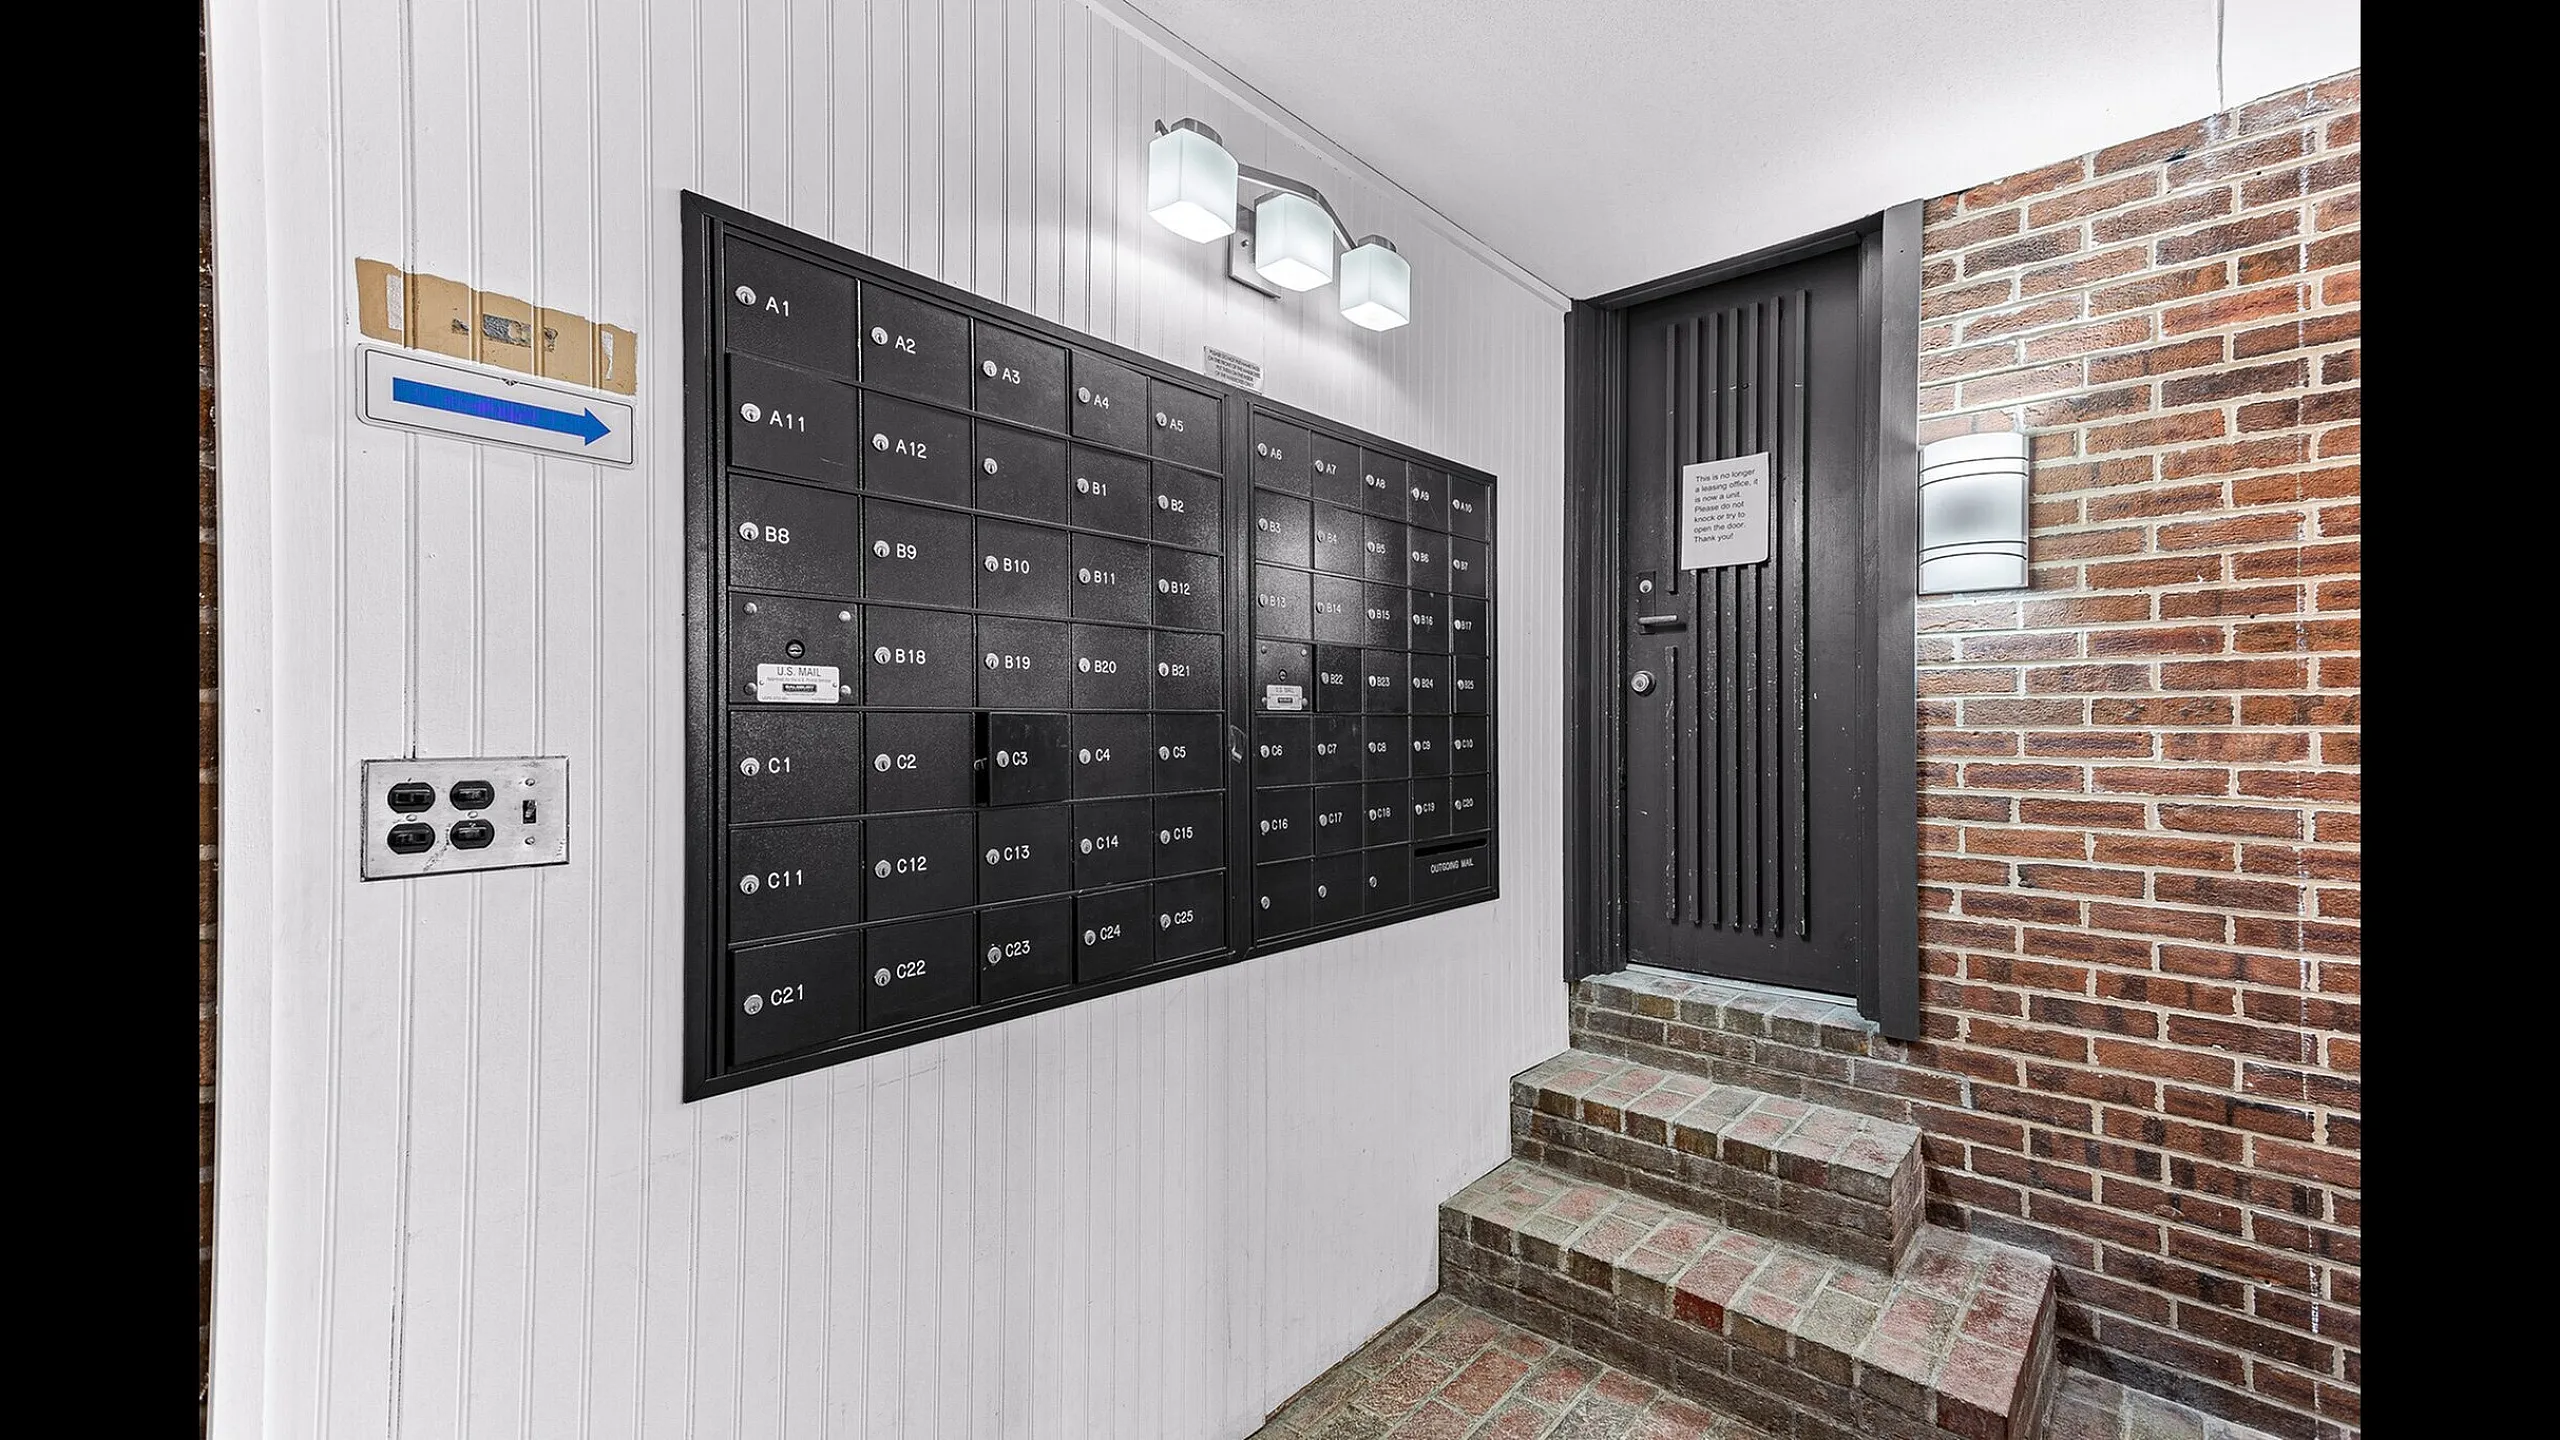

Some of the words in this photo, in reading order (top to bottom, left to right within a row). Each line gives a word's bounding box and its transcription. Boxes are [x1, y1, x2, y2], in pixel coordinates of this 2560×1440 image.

[765, 296, 789, 317] A1
[894, 335, 916, 355] A2
[1002, 367, 1021, 385] A3
[1093, 394, 1109, 410] A4
[769, 410, 805, 432] A11
[1169, 418, 1184, 432] A5
[895, 439, 927, 459] A12
[1270, 447, 1283, 461] A6
[1325, 463, 1337, 475] A7
[1731, 469, 1755, 478] longer
[1092, 481, 1107, 496] B1
[1375, 477, 1386, 489] A8
[1701, 483, 1727, 492] leasing
[1419, 490, 1431, 502] A9
[1170, 498, 1184, 513] B2
[1694, 504, 1719, 513] Please
[1720, 502, 1730, 510] do
[1269, 521, 1282, 534] B3
[1693, 525, 1712, 534] open
[765, 525, 790, 545] B8
[1326, 532, 1338, 543] B4
[1694, 535, 1716, 543] Thank
[896, 543, 917, 560] B9
[1375, 542, 1386, 554] B5
[1003, 557, 1030, 574] B10
[1458, 560, 1469, 571] B7
[1093, 570, 1115, 585] B11
[1171, 581, 1191, 596] B12
[1269, 594, 1287, 609] B13
[1326, 602, 1342, 615] B14
[1376, 609, 1391, 620] B15
[1420, 614, 1434, 626] B16
[1460, 620, 1472, 630] B17
[895, 648, 926, 665] B18
[1004, 654, 1031, 670] B19
[777, 666, 795, 676] U.S.
[798, 667, 821, 677] MAIL
[1094, 659, 1117, 674] B20
[1171, 664, 1190, 677] B21
[1330, 673, 1344, 685] B22
[1376, 676, 1391, 687] B23
[1421, 678, 1434, 689] B24
[1271, 744, 1283, 756] C6
[1327, 743, 1337, 754] C7
[1376, 741, 1387, 753] C8
[1422, 740, 1431, 751] C9
[1462, 738, 1474, 749] C10
[1012, 751, 1028, 766] C3
[1095, 748, 1111, 762] C4
[1172, 745, 1187, 759] C5
[768, 756, 790, 774] C1
[896, 753, 917, 770] C2
[1423, 802, 1435, 813] C19
[1462, 797, 1474, 808] C20
[1328, 811, 1343, 824] C17
[1376, 806, 1391, 819] C18
[1271, 818, 1289, 831] C16
[1173, 826, 1194, 840] C15
[1096, 835, 1119, 850] C14
[1003, 844, 1030, 861] C13
[896, 855, 927, 874] C12
[1430, 860, 1459, 873] OUTGOING
[1460, 858, 1474, 868] MAIL
[767, 869, 802, 889] C11
[1174, 909, 1194, 925] C25
[1099, 924, 1121, 941] C24
[1005, 940, 1031, 958] C23
[896, 959, 926, 979] C22
[770, 983, 803, 1006] C21
